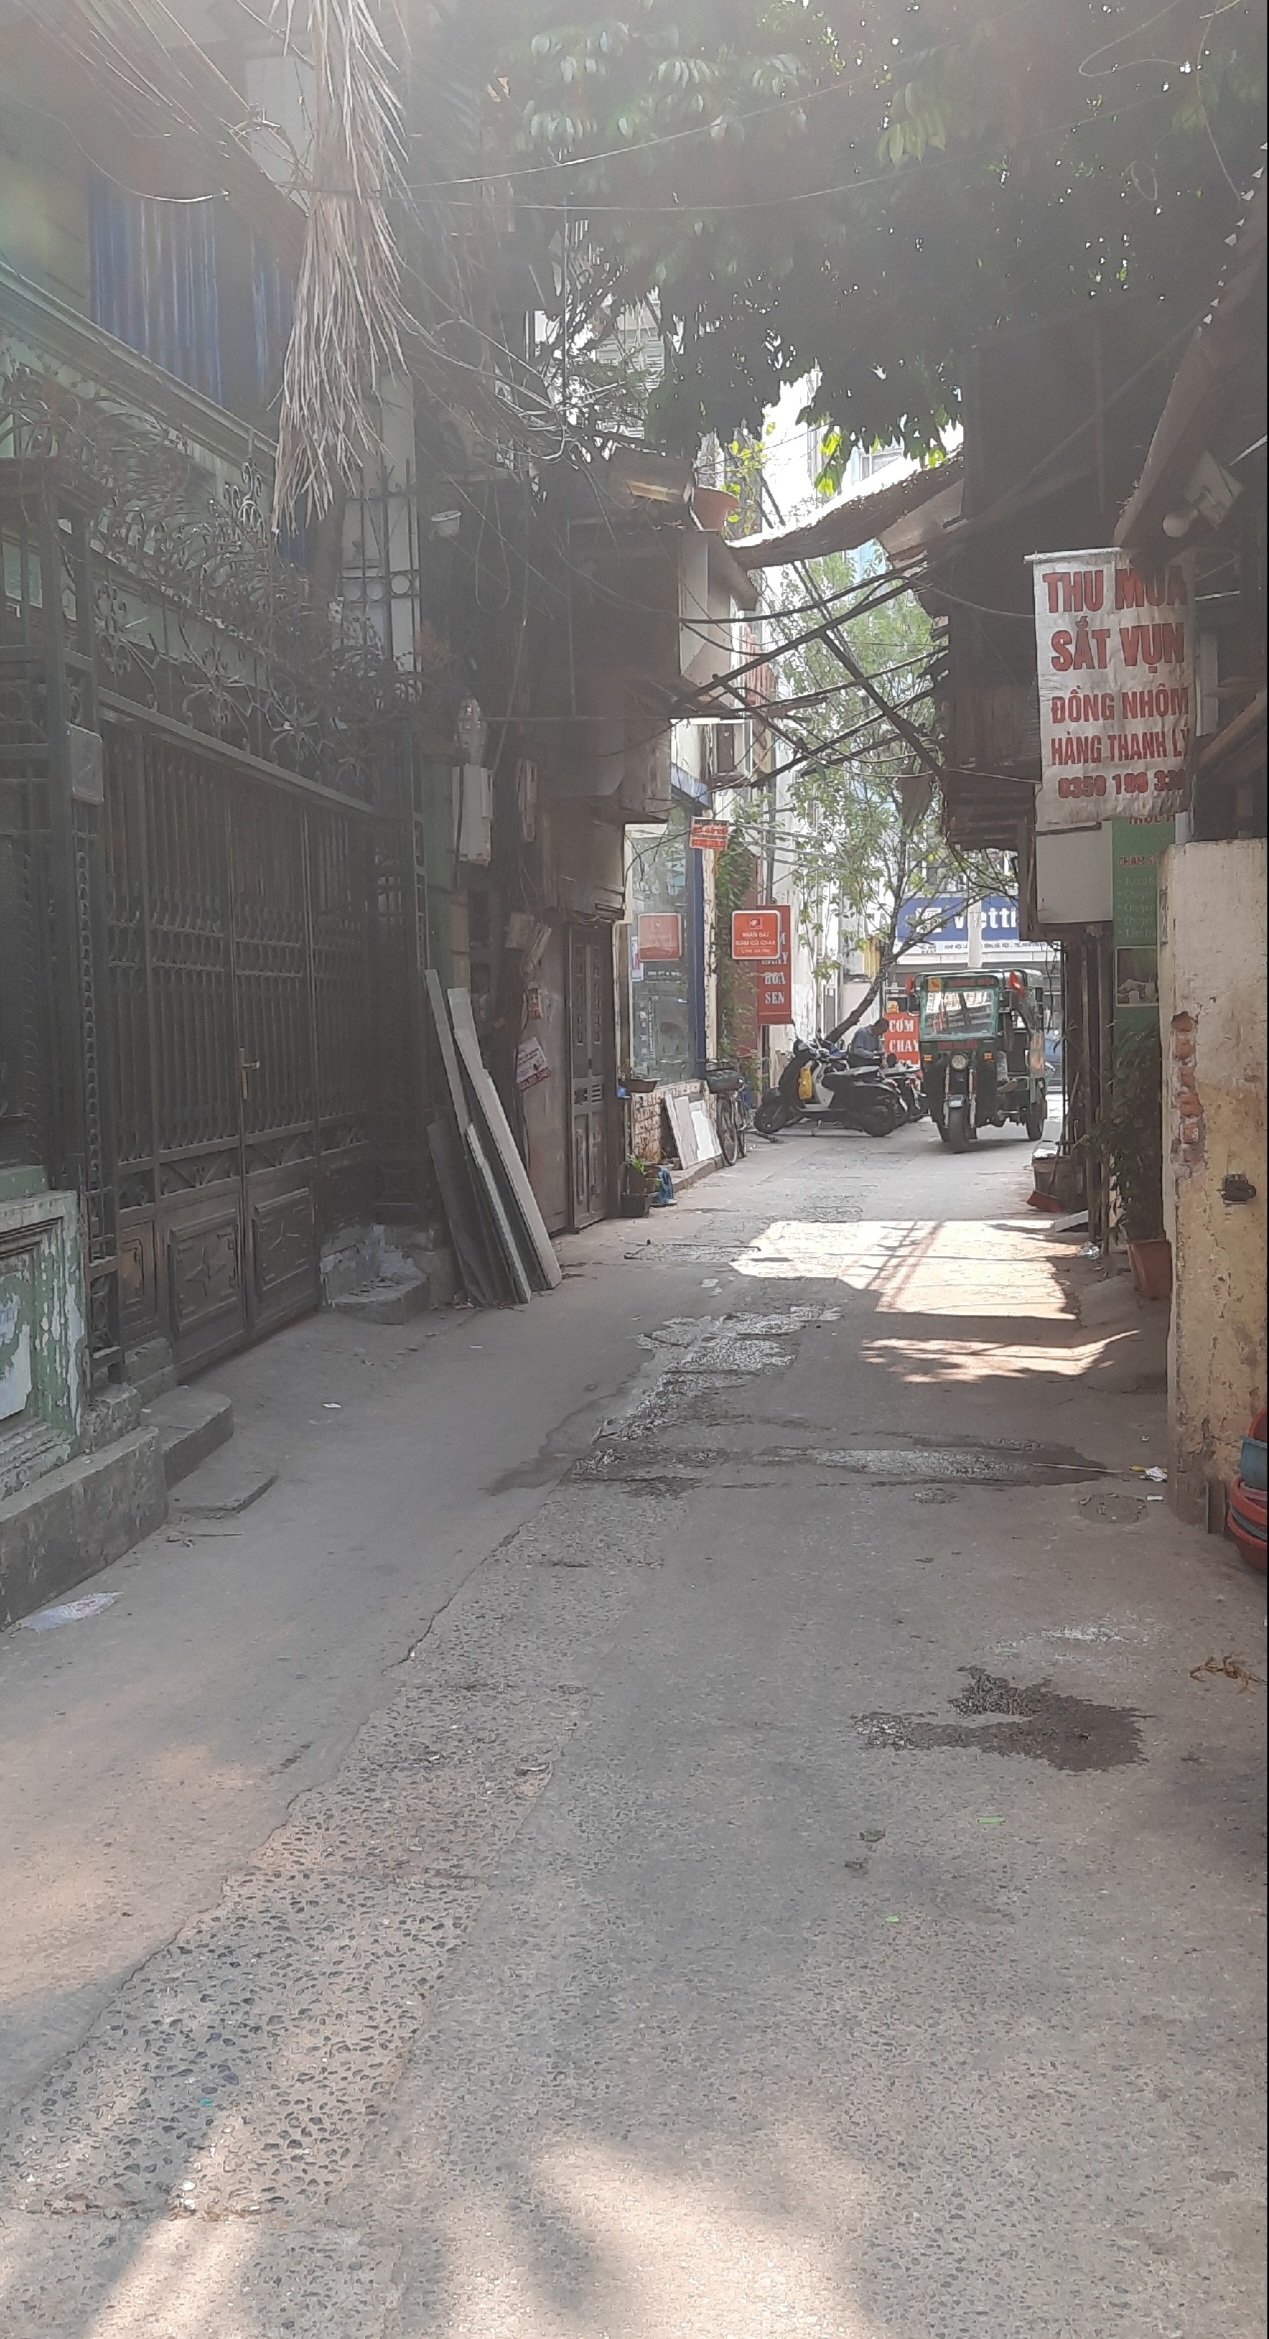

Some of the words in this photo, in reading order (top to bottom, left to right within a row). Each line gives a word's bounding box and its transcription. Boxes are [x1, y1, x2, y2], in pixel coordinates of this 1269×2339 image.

[1042, 569, 1104, 614] THU
[1115, 564, 1189, 611] MUA
[1051, 615, 1111, 672] SẮT
[1119, 622, 1185, 674] VỤN
[1051, 685, 1115, 725] ĐỒNG
[1122, 682, 1189, 720] NHÔM
[1050, 731, 1102, 766] HÀNG
[1107, 731, 1168, 762] THANH
[764, 992, 785, 1005] SEN
[888, 1017, 914, 1033] CƠM
[889, 1039, 919, 1053] CHAY
